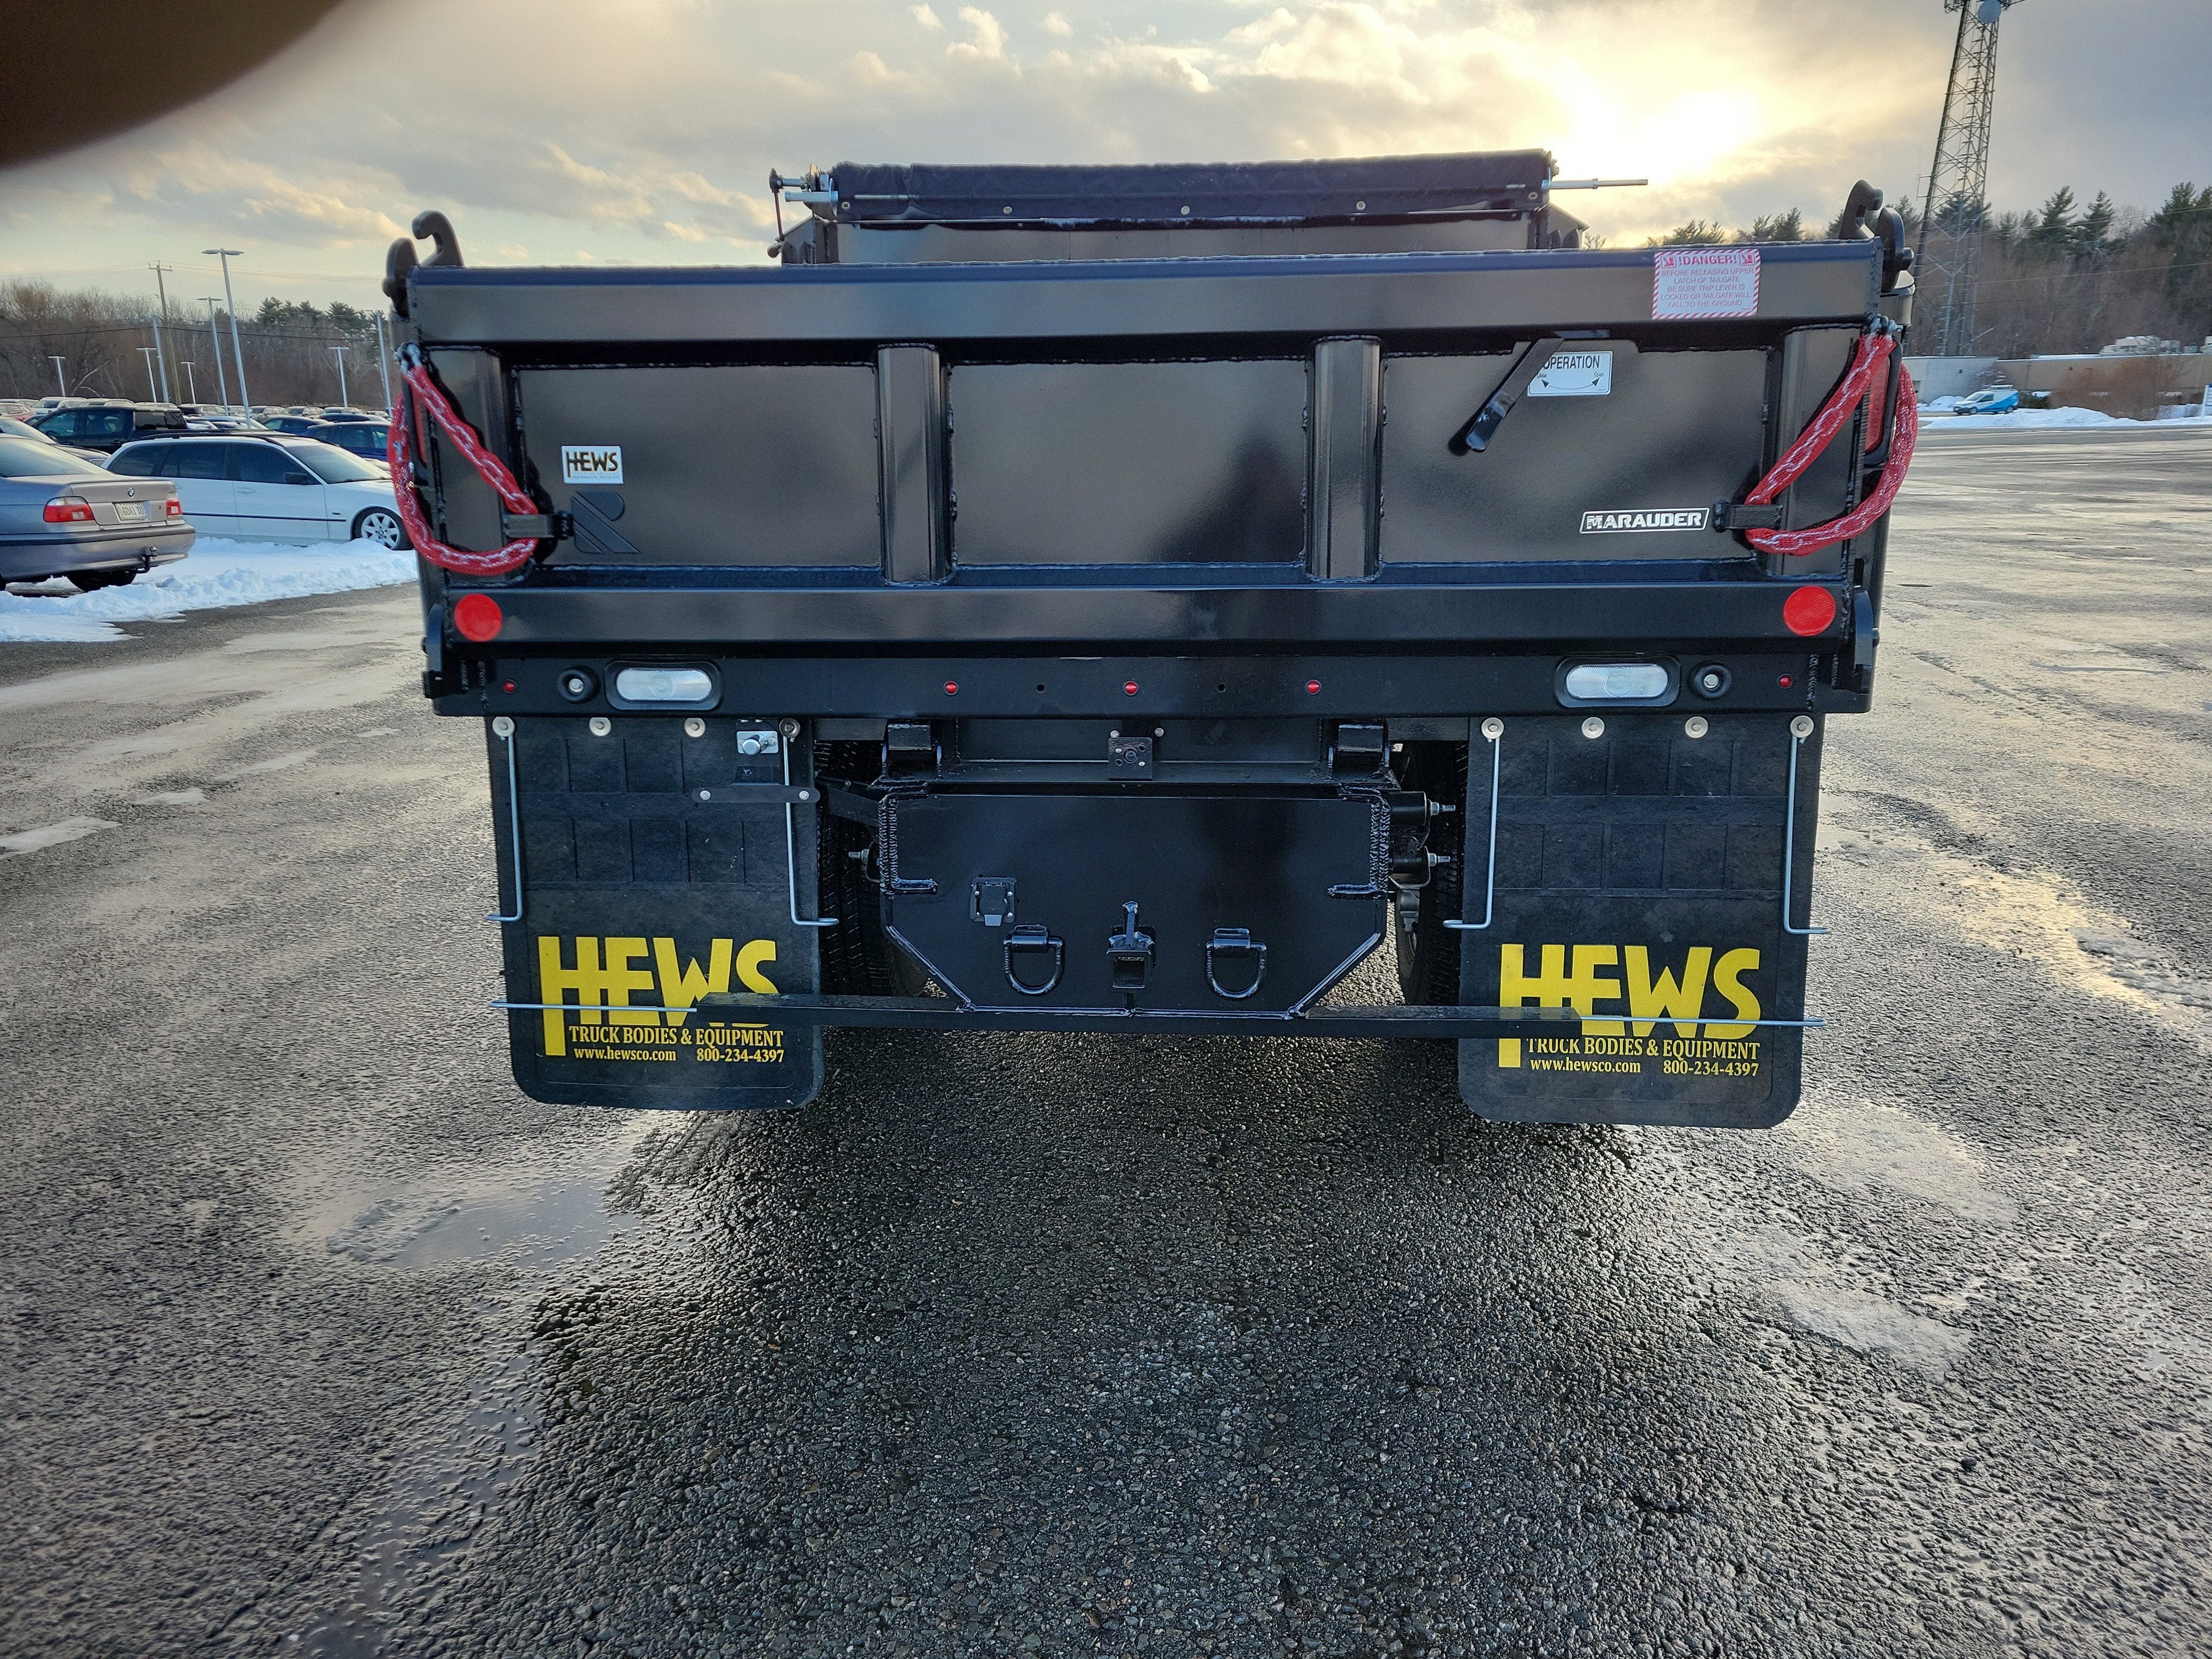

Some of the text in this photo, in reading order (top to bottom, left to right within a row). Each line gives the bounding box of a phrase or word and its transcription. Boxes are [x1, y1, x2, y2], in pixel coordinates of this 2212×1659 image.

[566, 451, 618, 478] HEWS
[1586, 512, 1702, 529] MARAUDER
[538, 936, 778, 1056] HEWS
[1498, 944, 1760, 1068] HEWS
[569, 1026, 783, 1048] TRUCK BODIES & EQUIPMENT
[574, 1046, 784, 1063] www.hewsco.com 800-234-4397
[1526, 1037, 1760, 1060] TRUCK BODIES & EQUIPMENT
[1530, 1057, 1759, 1077] www.hewsco.com 800-234-4397
